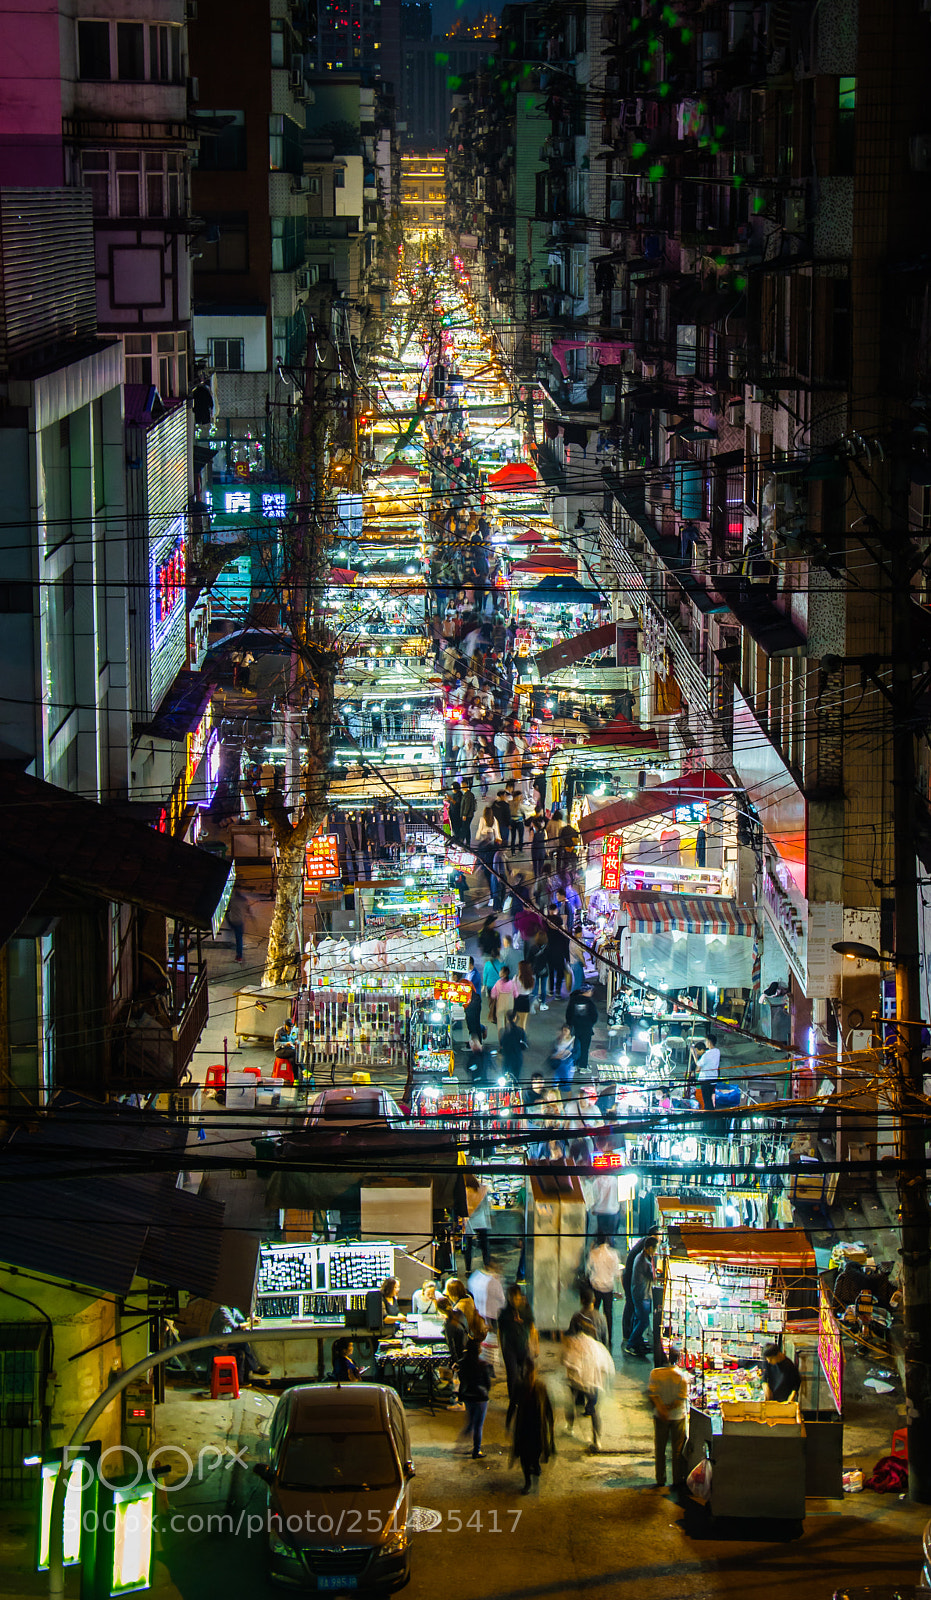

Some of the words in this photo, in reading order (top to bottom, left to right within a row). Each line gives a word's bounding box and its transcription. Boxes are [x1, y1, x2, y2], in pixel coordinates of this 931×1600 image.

[605, 836, 619, 888] 化妆品
[446, 957, 467, 970] 贴膜
